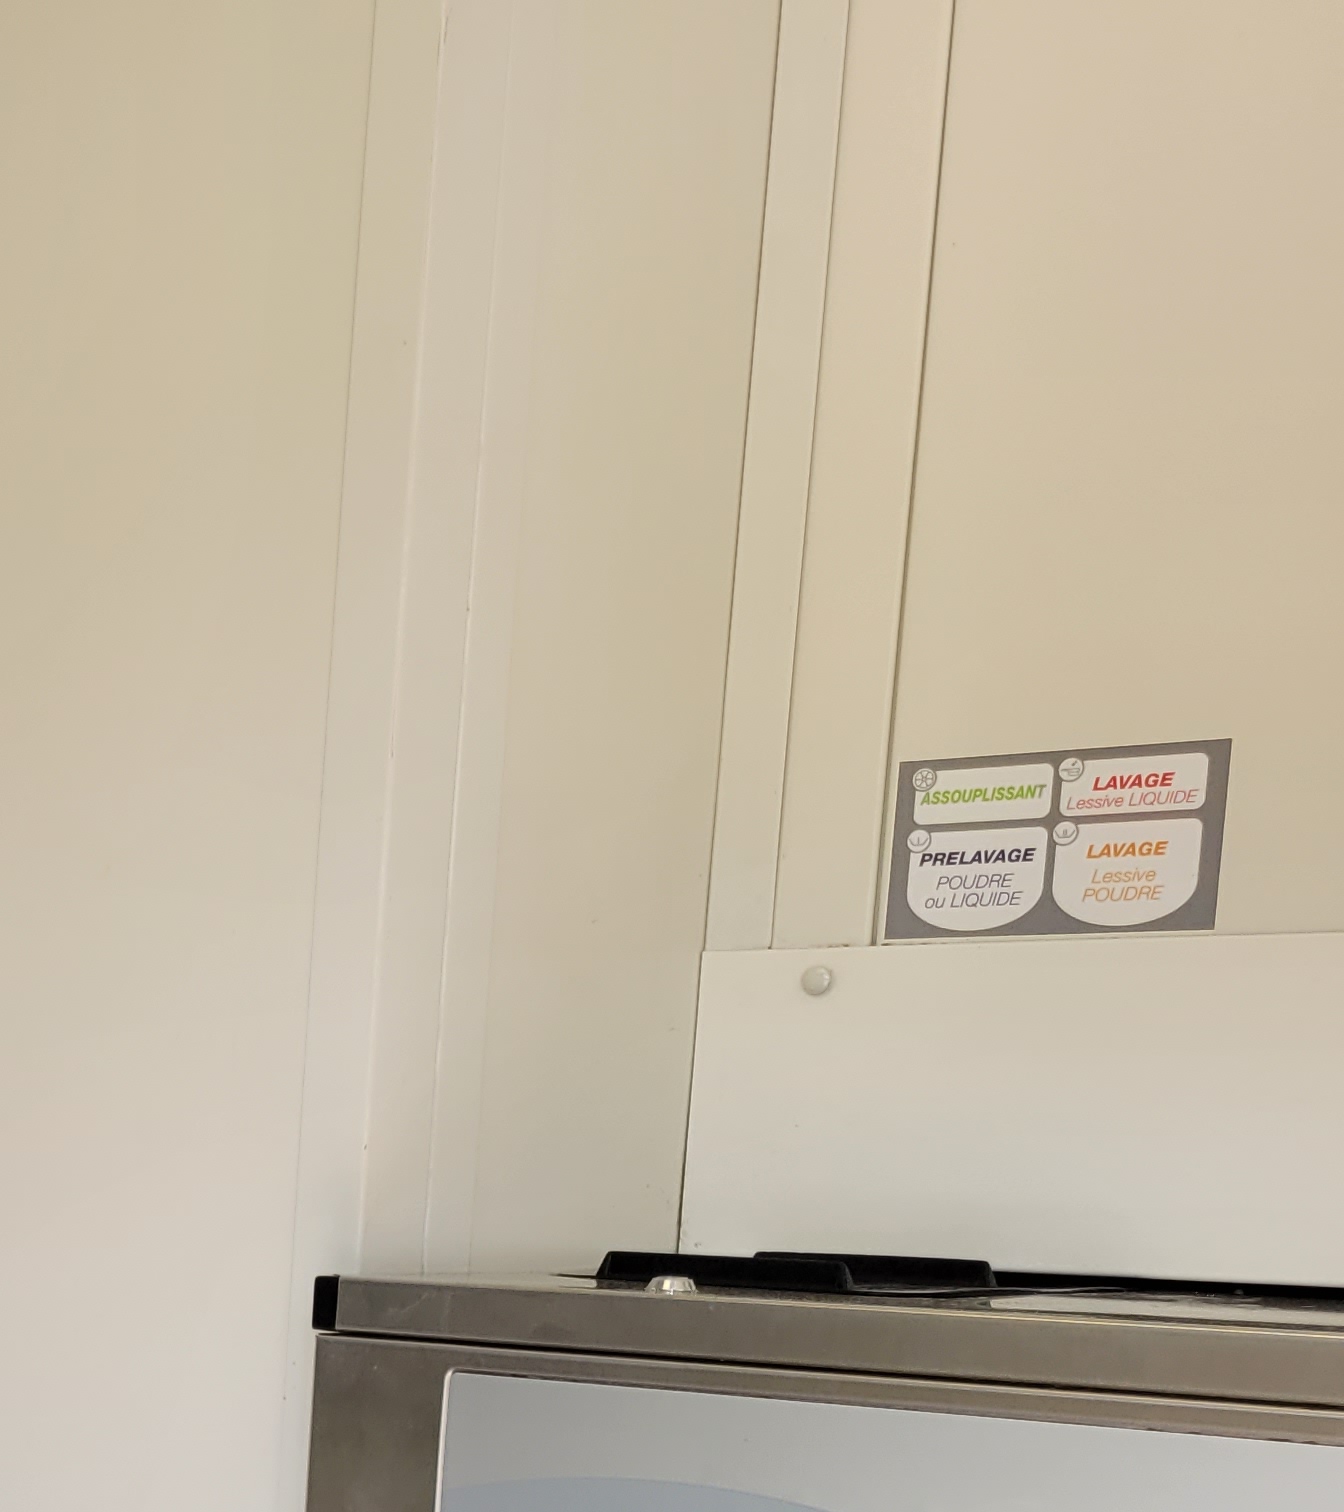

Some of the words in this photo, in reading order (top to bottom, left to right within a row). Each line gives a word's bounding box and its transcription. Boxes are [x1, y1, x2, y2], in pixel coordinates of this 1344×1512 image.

[1092, 772, 1176, 791] LAVAGE
[921, 784, 1047, 805] ASSOUPLISSANT
[1066, 795, 1124, 810] Lessive
[1129, 789, 1199, 806] LIQUIDE
[919, 848, 1037, 867] PRELAVAGE
[1086, 841, 1168, 859] LAVAGE
[936, 873, 1014, 890] POUDRE
[1092, 868, 1156, 883] Lessive
[925, 896, 944, 909] ou
[950, 891, 1023, 909] LIQUIDE
[1082, 886, 1164, 902] POUDRE
